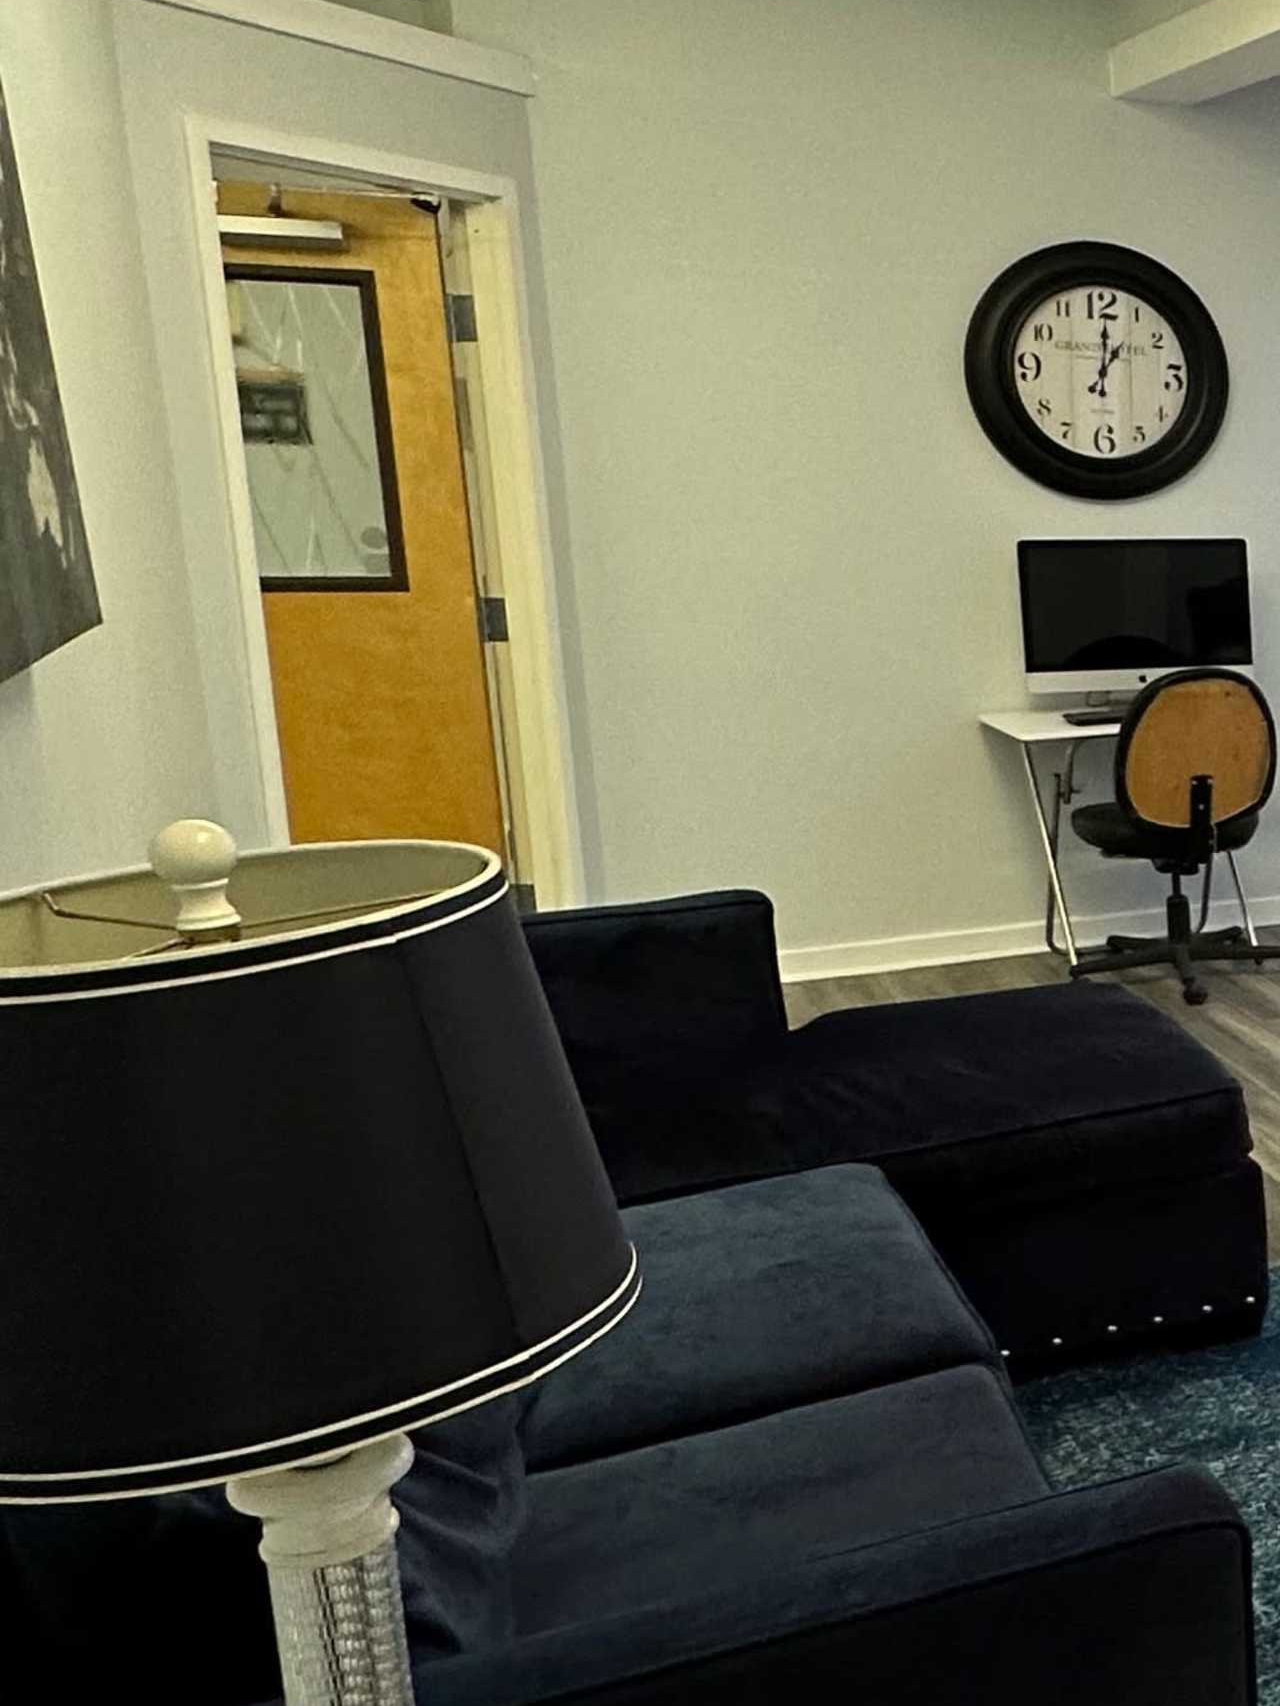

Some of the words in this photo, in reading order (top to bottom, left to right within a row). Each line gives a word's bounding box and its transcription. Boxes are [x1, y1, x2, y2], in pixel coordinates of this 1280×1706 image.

[1056, 300, 1070, 318] 11
[1086, 291, 1118, 321] 12
[1134, 307, 1140, 323] 1
[1033, 323, 1053, 342] 10
[1152, 332, 1164, 349] 2
[1017, 352, 1041, 382] 9
[1164, 364, 1184, 392] 3
[1036, 398, 1051, 416] 8
[1156, 406, 1169, 423] 4
[1061, 422, 1073, 439] 7
[1093, 423, 1116, 454] 6
[1133, 426, 1146, 443] 5
